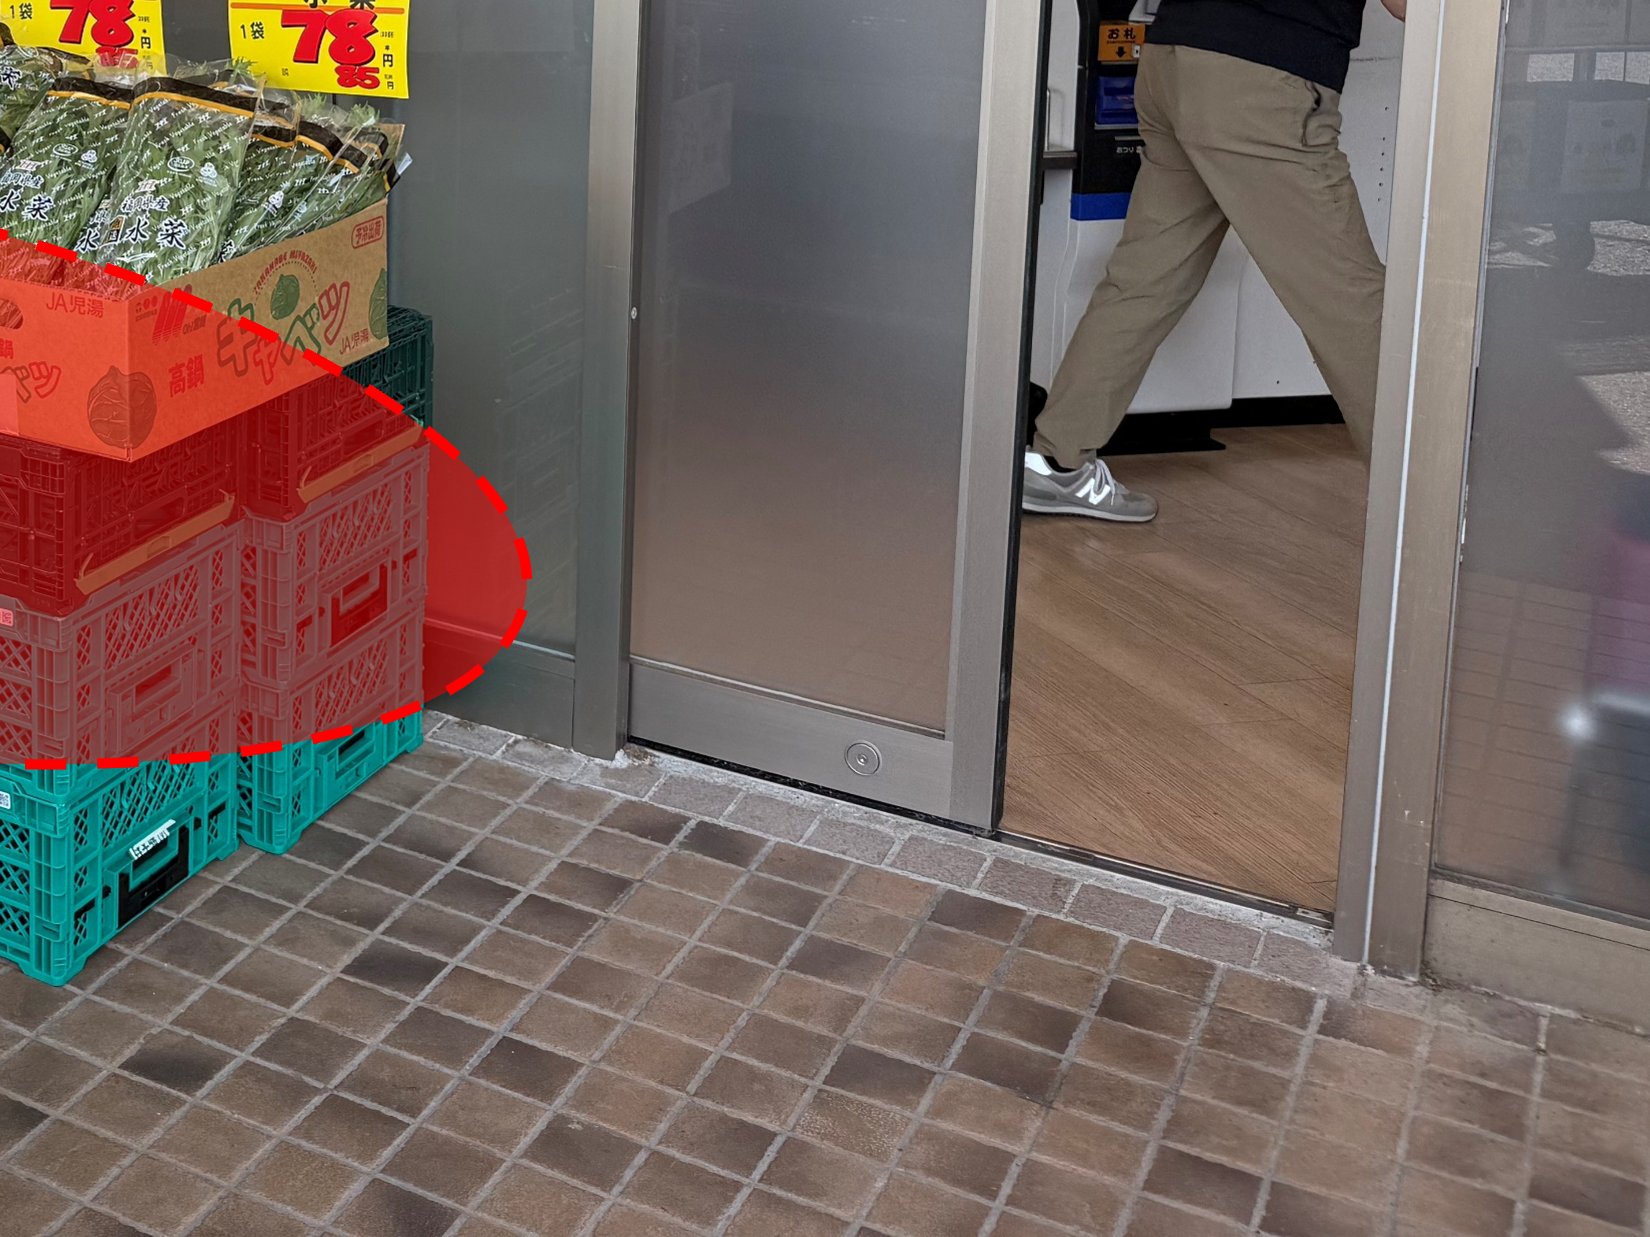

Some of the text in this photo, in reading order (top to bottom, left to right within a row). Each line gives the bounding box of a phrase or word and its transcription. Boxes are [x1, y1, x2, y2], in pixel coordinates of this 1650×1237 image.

[9, 3, 34, 21] 1袋
[140, 36, 152, 50] 円
[240, 7, 394, 68] 1袋 78 円
[1107, 27, 1136, 40] お札
[334, 64, 395, 91] 85 円
[121, 195, 171, 213] 福岡県産
[124, 212, 191, 250] 水菜
[45, 291, 105, 319] JA児湯
[339, 327, 370, 355] JA児湯
[168, 353, 205, 398] 高鍋
